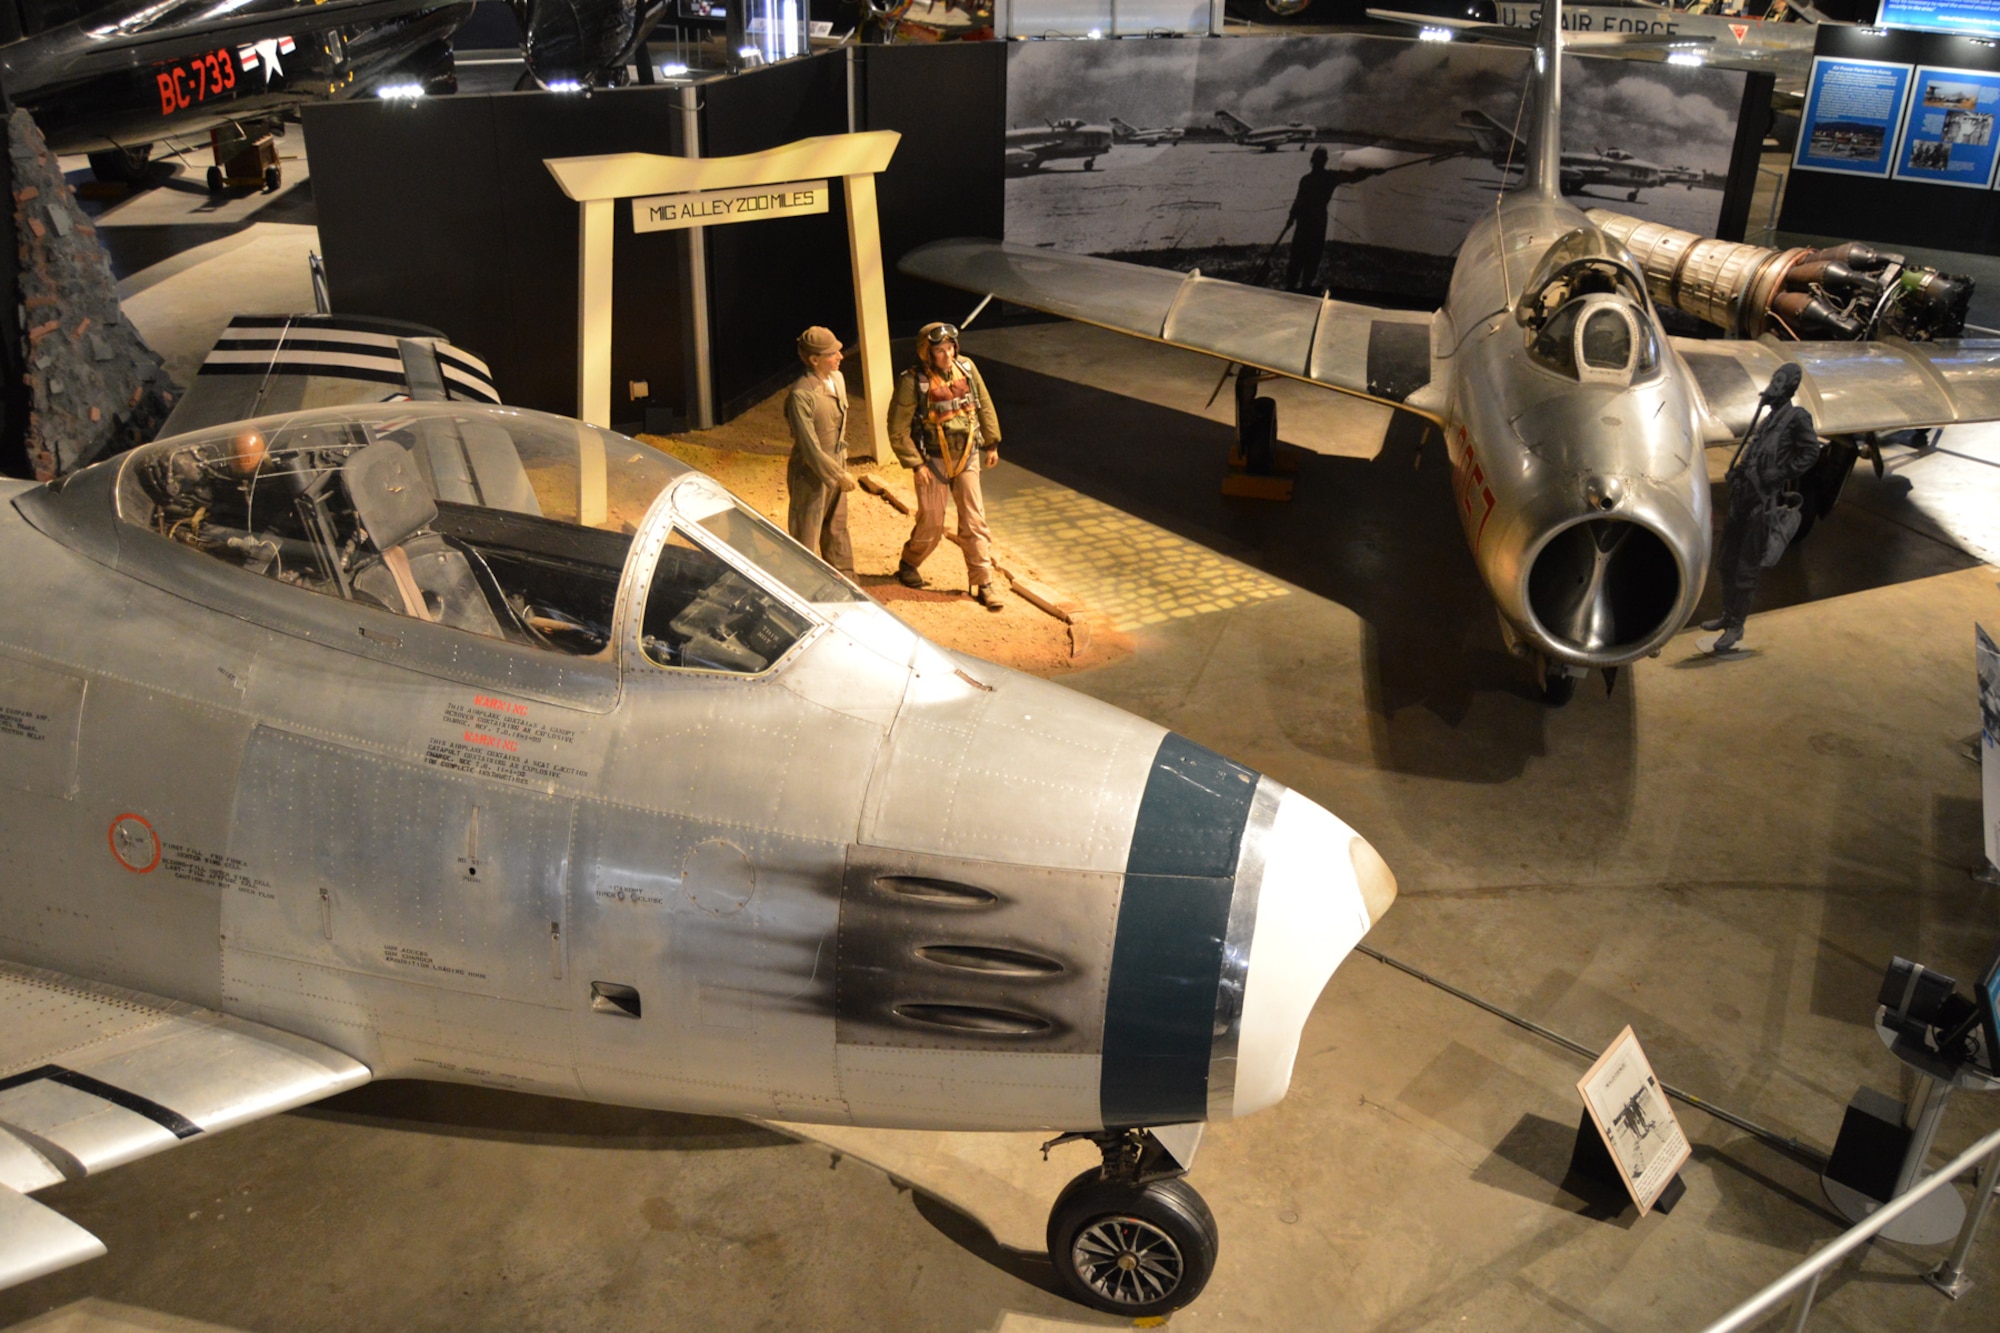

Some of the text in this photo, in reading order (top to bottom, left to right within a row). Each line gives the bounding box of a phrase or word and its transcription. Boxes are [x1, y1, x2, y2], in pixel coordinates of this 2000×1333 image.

[1561, 14, 1592, 32] AIR
[1603, 17, 1680, 36] FORCE
[156, 48, 236, 116] BC-733
[649, 205, 677, 222] MIG
[680, 199, 733, 219] ALLEY
[771, 190, 814, 209] MILES
[448, 702, 465, 714] THIS
[467, 707, 502, 722] AIRPLANE
[503, 715, 539, 730] CONTAINS
[474, 694, 529, 716] WARNING
[464, 730, 518, 752] WARNING
[534, 728, 574, 745] EXPLOSIVE
[427, 744, 461, 757] CATAPULT
[522, 765, 561, 780] EXPLOSIVE
[430, 737, 447, 748] THIS
[449, 741, 483, 756] AIRPLANE
[486, 750, 521, 763] CONTAINS
[532, 759, 550, 770] SEAT
[552, 764, 589, 778] EJECTION
